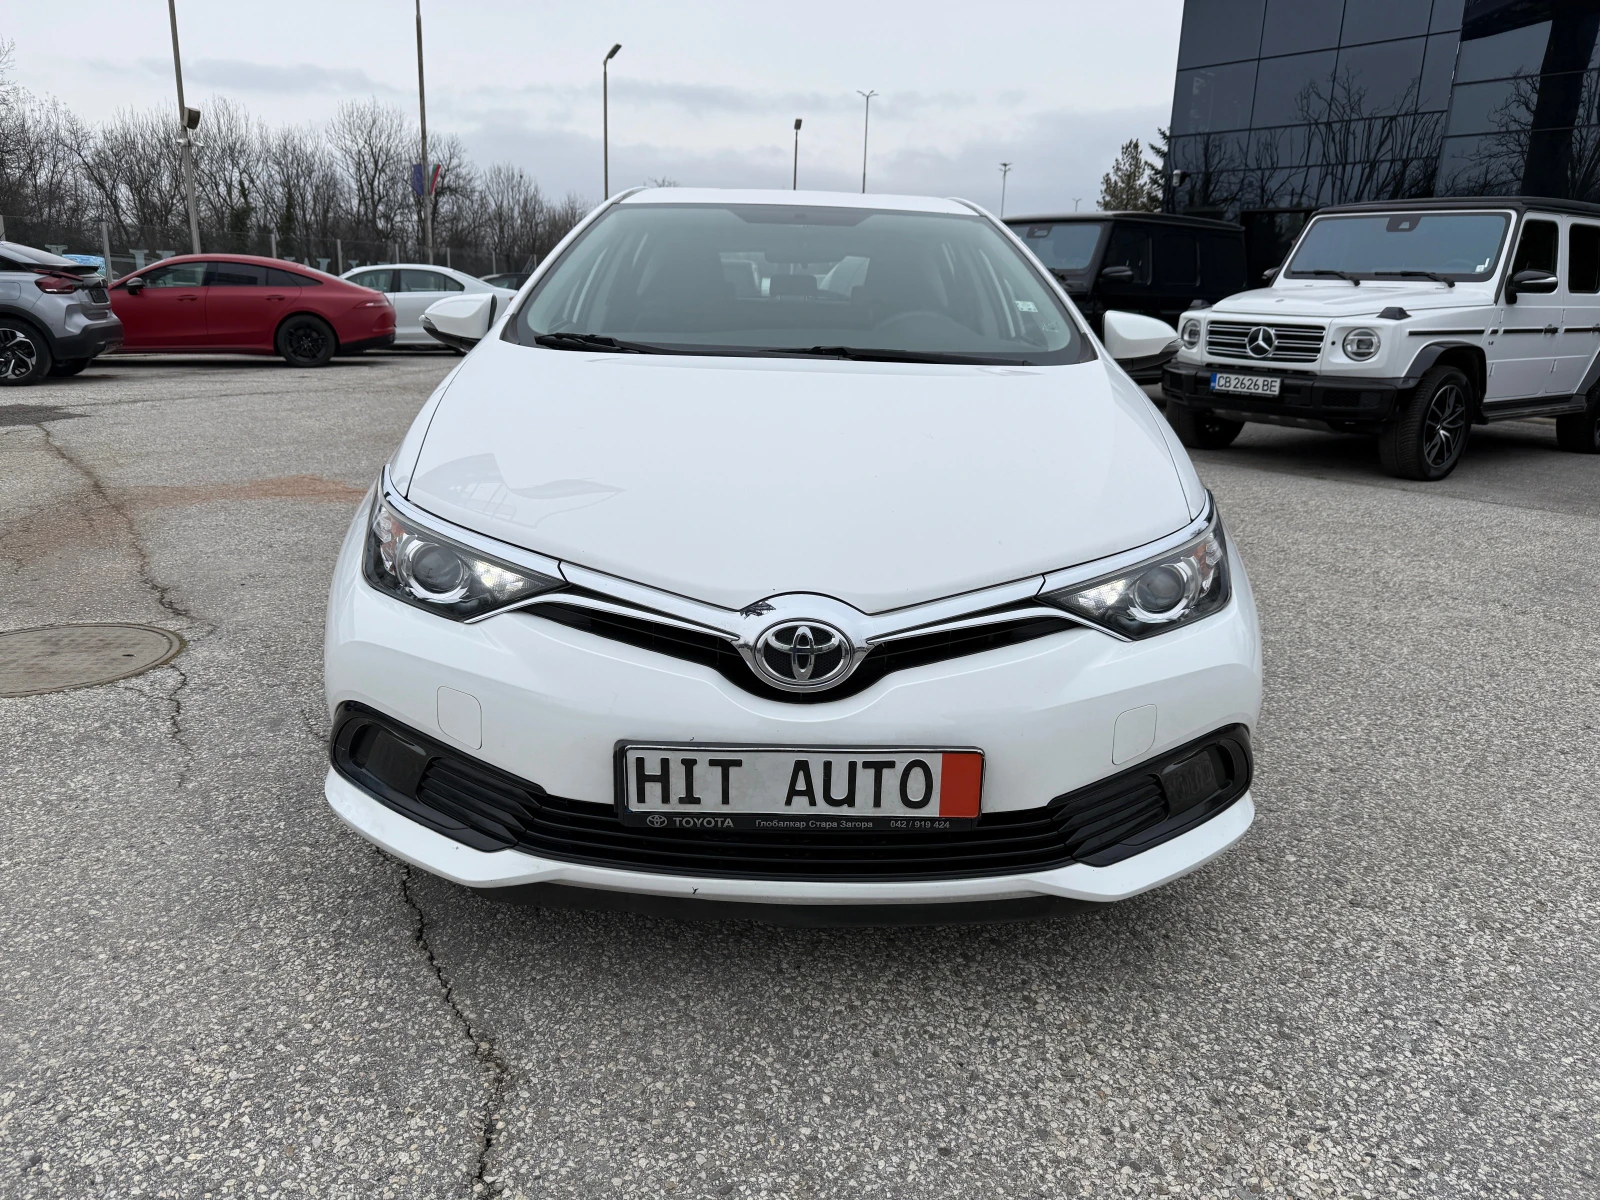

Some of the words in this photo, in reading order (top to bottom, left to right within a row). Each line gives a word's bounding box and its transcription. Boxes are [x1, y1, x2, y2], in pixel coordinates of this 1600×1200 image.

[1217, 375, 1231, 389] CB
[1233, 376, 1260, 391] 2626
[1261, 379, 1278, 393] BE
[635, 757, 743, 805] HIT
[784, 758, 934, 809] AUTO
[673, 817, 734, 828] TOYOTA
[755, 819, 806, 829] Глобалкар
[808, 820, 838, 829] Стара
[840, 820, 873, 829] Загора
[890, 820, 907, 829] 042
[914, 820, 931, 829] 919
[933, 820, 950, 829] 424
